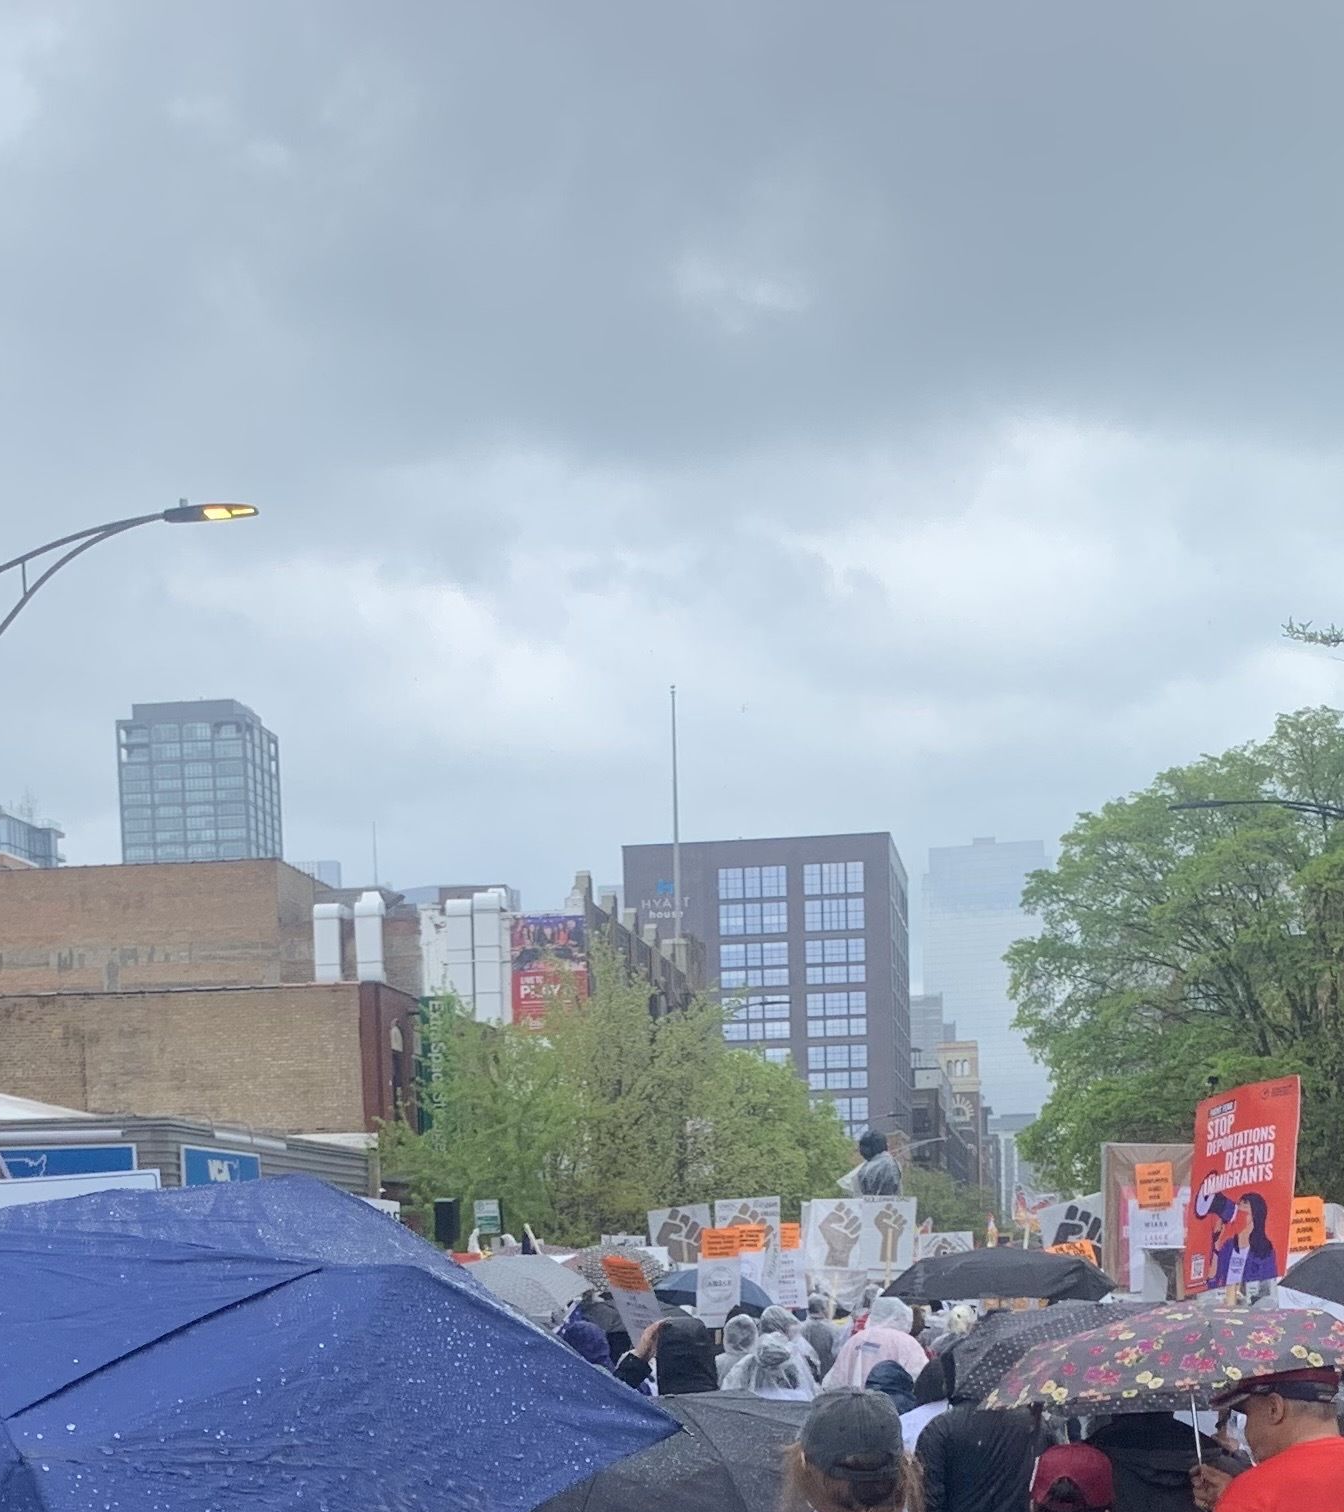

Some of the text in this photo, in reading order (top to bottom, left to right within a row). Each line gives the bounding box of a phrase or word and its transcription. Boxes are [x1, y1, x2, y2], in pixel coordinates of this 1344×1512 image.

[1207, 1113, 1235, 1140] STOP
[1207, 1125, 1276, 1157] DEPORTATIONS
[1225, 1142, 1275, 1171] DEFEND
[1201, 1163, 1273, 1196] IMMIGRANTS
